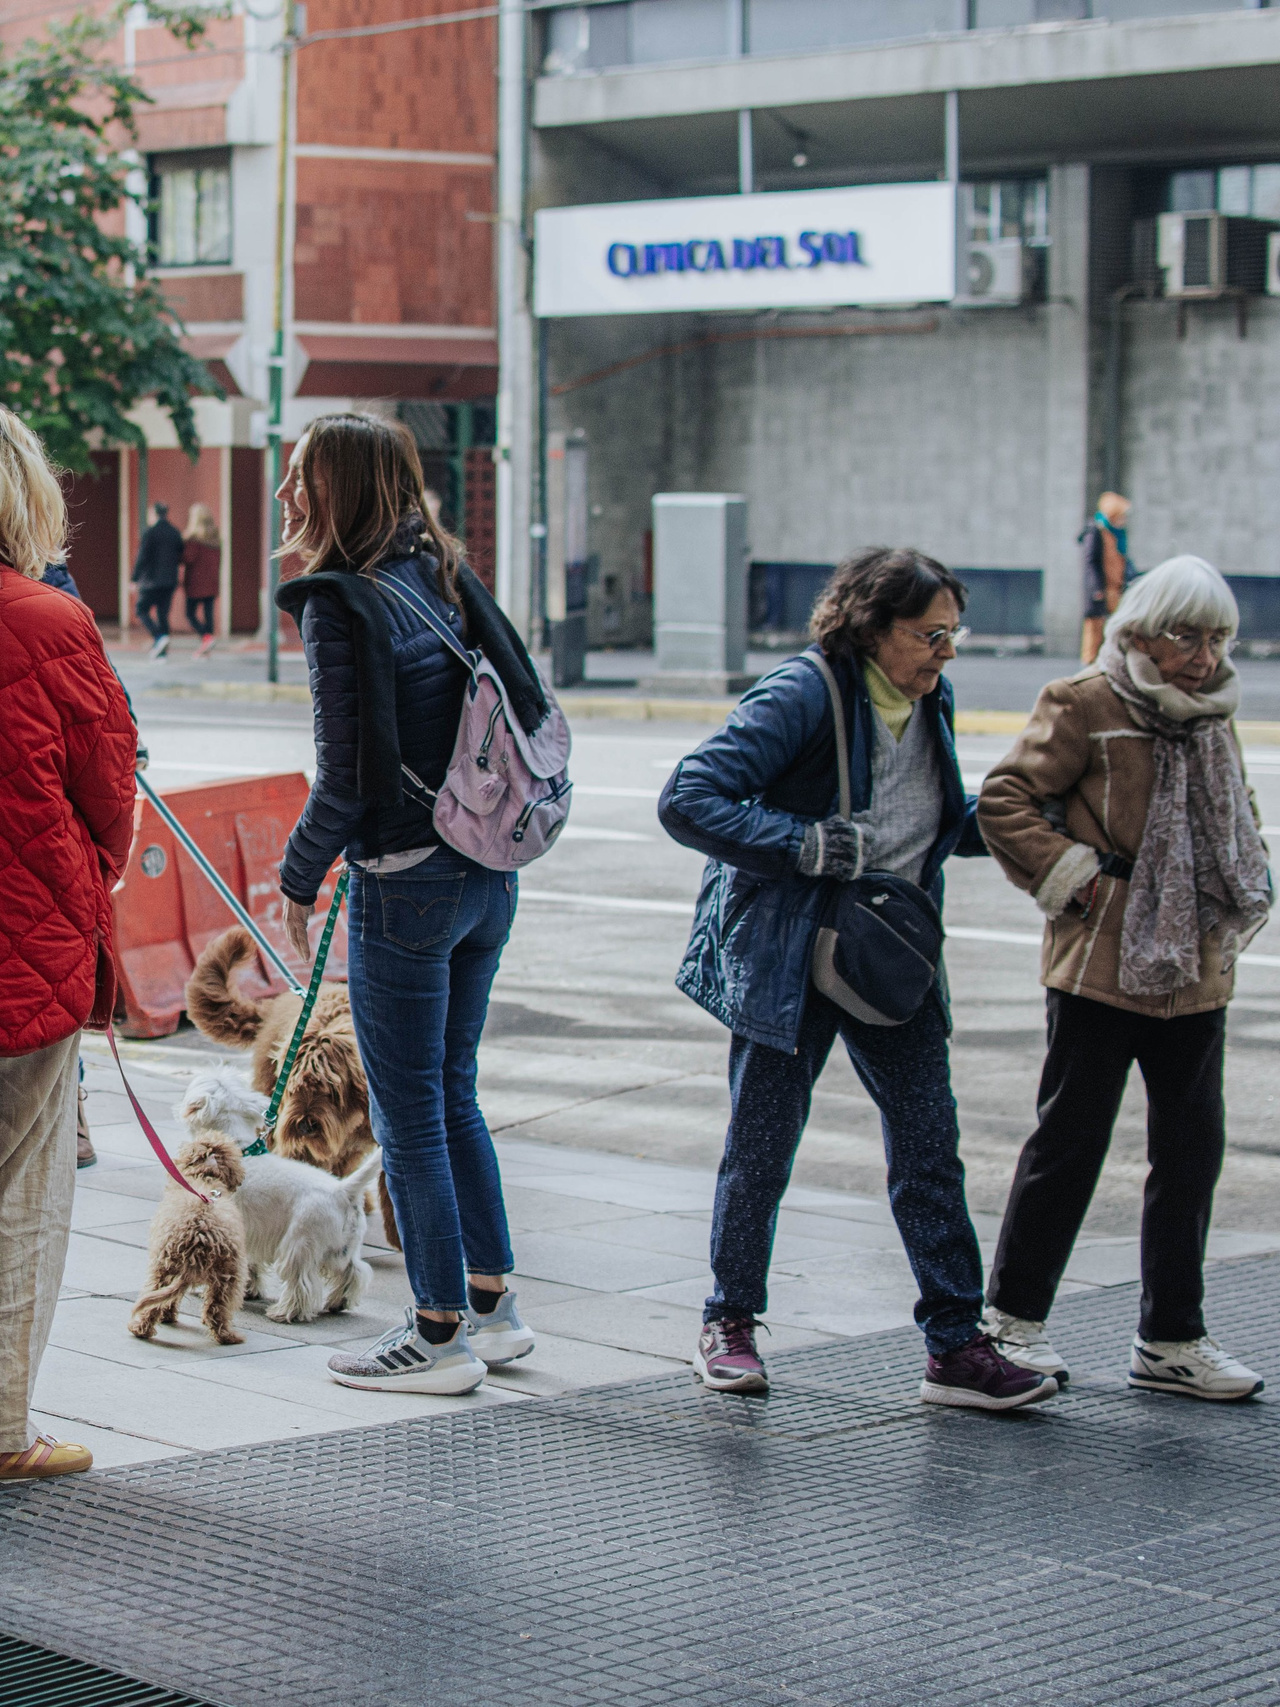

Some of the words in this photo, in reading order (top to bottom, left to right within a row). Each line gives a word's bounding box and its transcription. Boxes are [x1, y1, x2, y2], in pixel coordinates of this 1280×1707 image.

[608, 241, 725, 277] CLINICA
[733, 236, 788, 270] DEL
[797, 231, 867, 268] SOL
